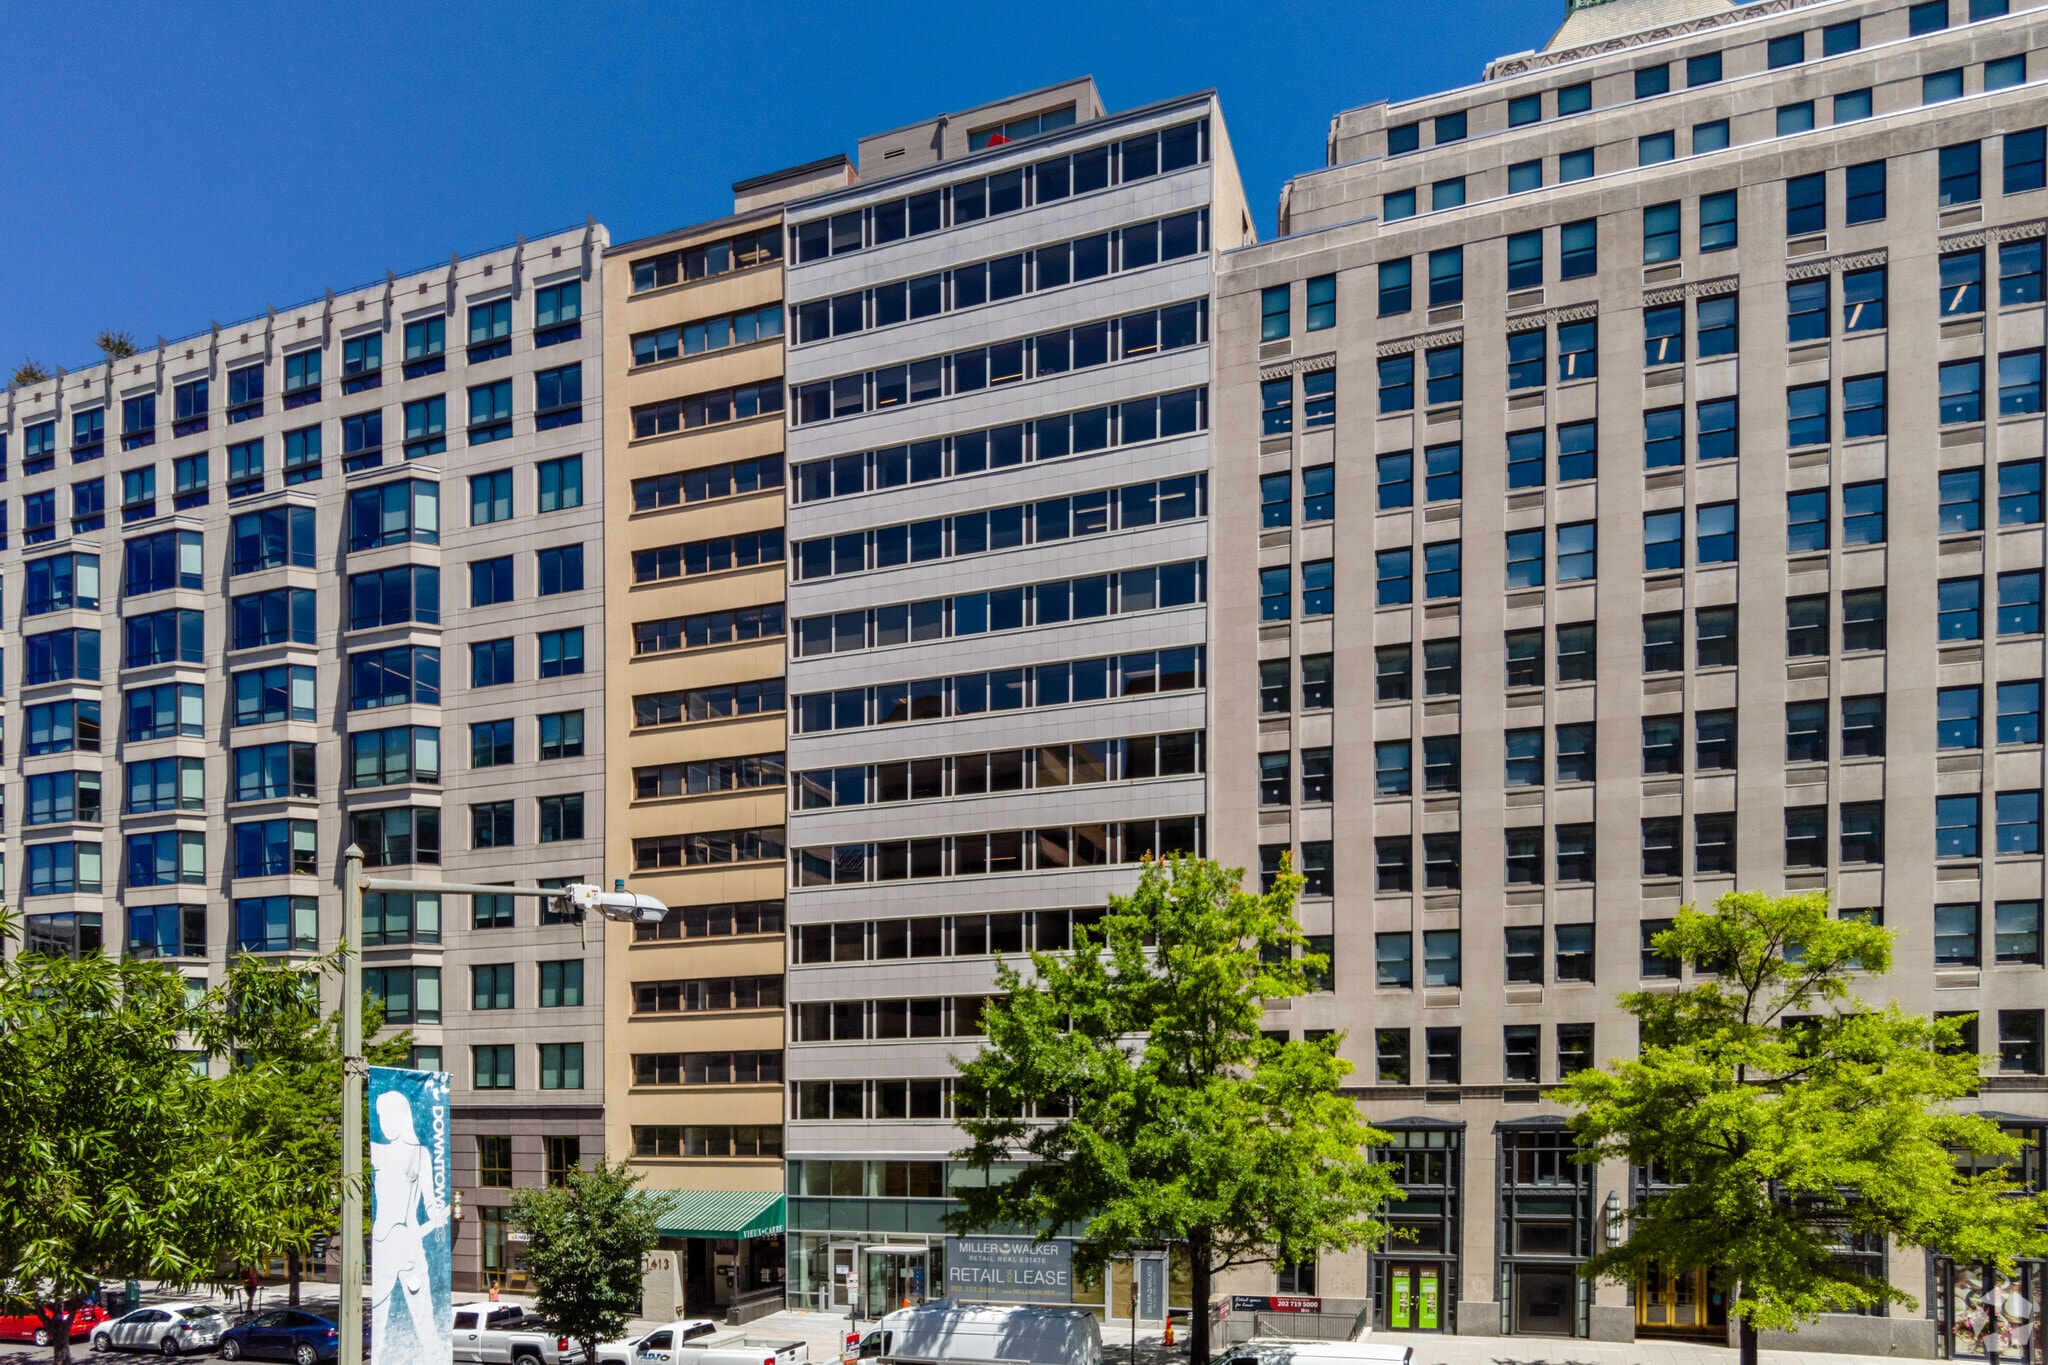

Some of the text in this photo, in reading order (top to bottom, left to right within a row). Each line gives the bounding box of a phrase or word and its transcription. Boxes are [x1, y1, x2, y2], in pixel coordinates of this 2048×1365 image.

[959, 1242, 1059, 1256] MILLER WALKER
[641, 1258, 670, 1271] 1413
[949, 1266, 1005, 1283] RETAIL
[1014, 1269, 1067, 1285] LEASE
